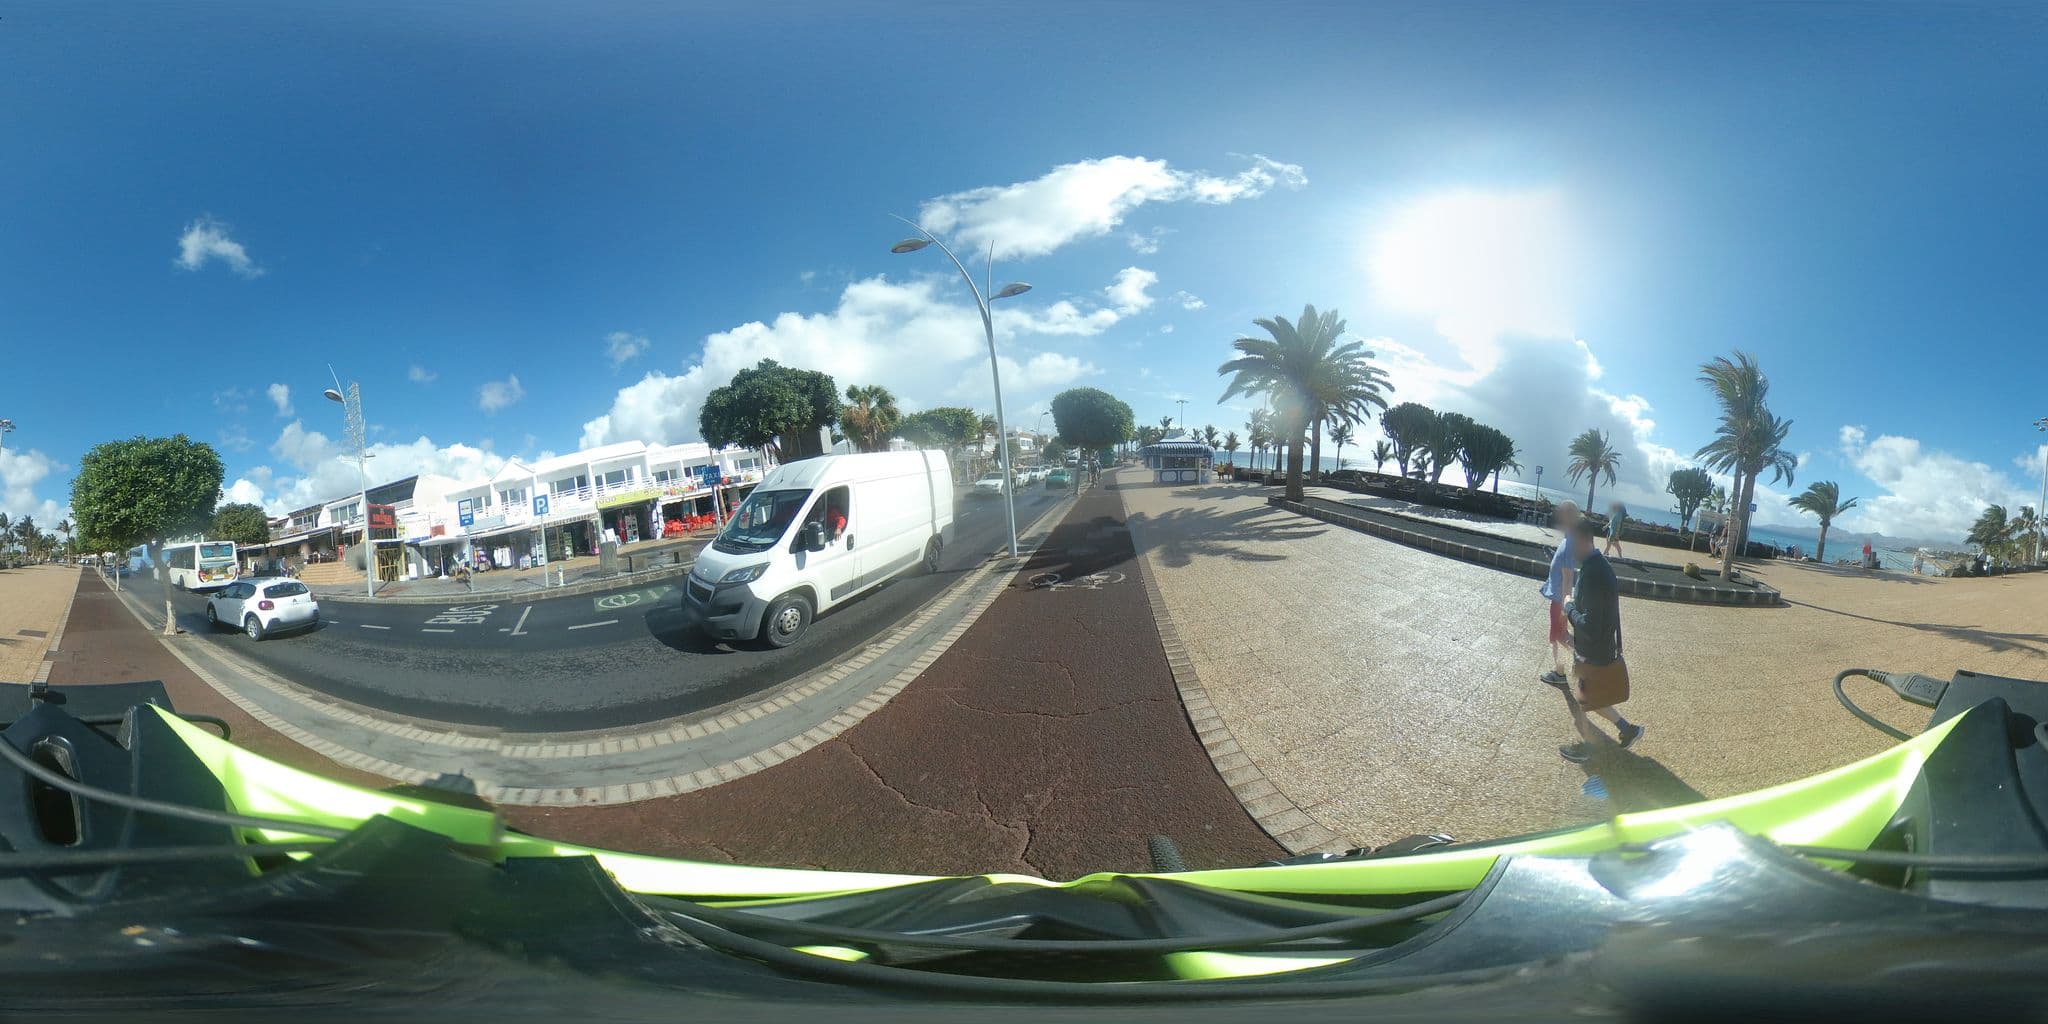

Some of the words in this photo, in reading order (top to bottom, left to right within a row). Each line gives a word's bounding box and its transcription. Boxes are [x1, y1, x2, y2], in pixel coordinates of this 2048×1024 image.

[704, 472, 720, 480] TAXI
[536, 498, 546, 513] P
[424, 604, 500, 624] BUS
